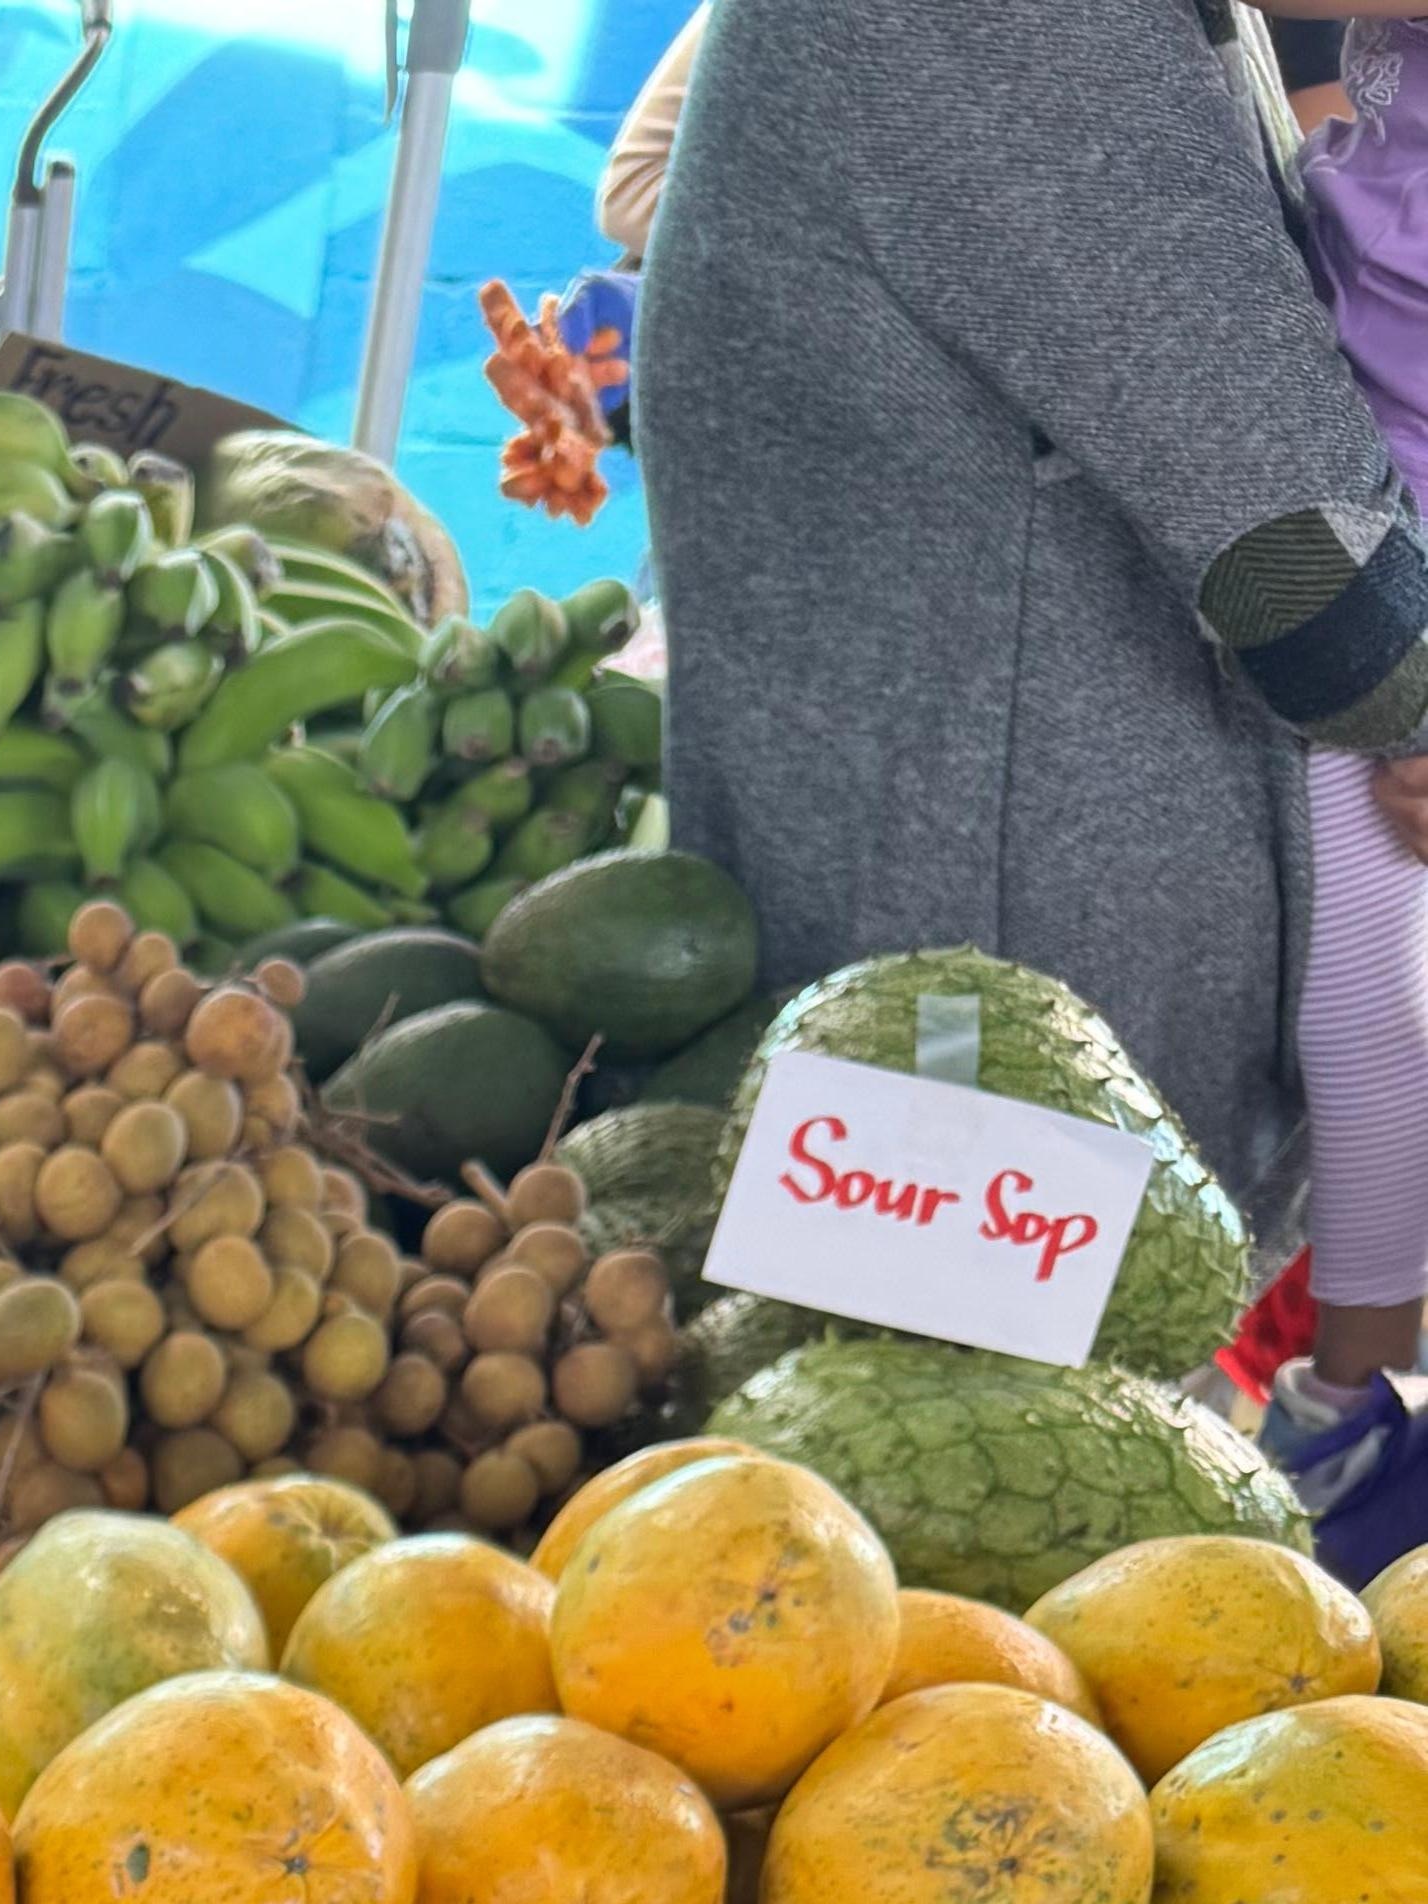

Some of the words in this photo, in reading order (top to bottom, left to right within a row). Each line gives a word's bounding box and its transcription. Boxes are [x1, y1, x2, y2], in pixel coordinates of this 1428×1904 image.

[10, 345, 178, 448] Fresh
[778, 1115, 960, 1226] Sour
[978, 1169, 1098, 1282] Sop
